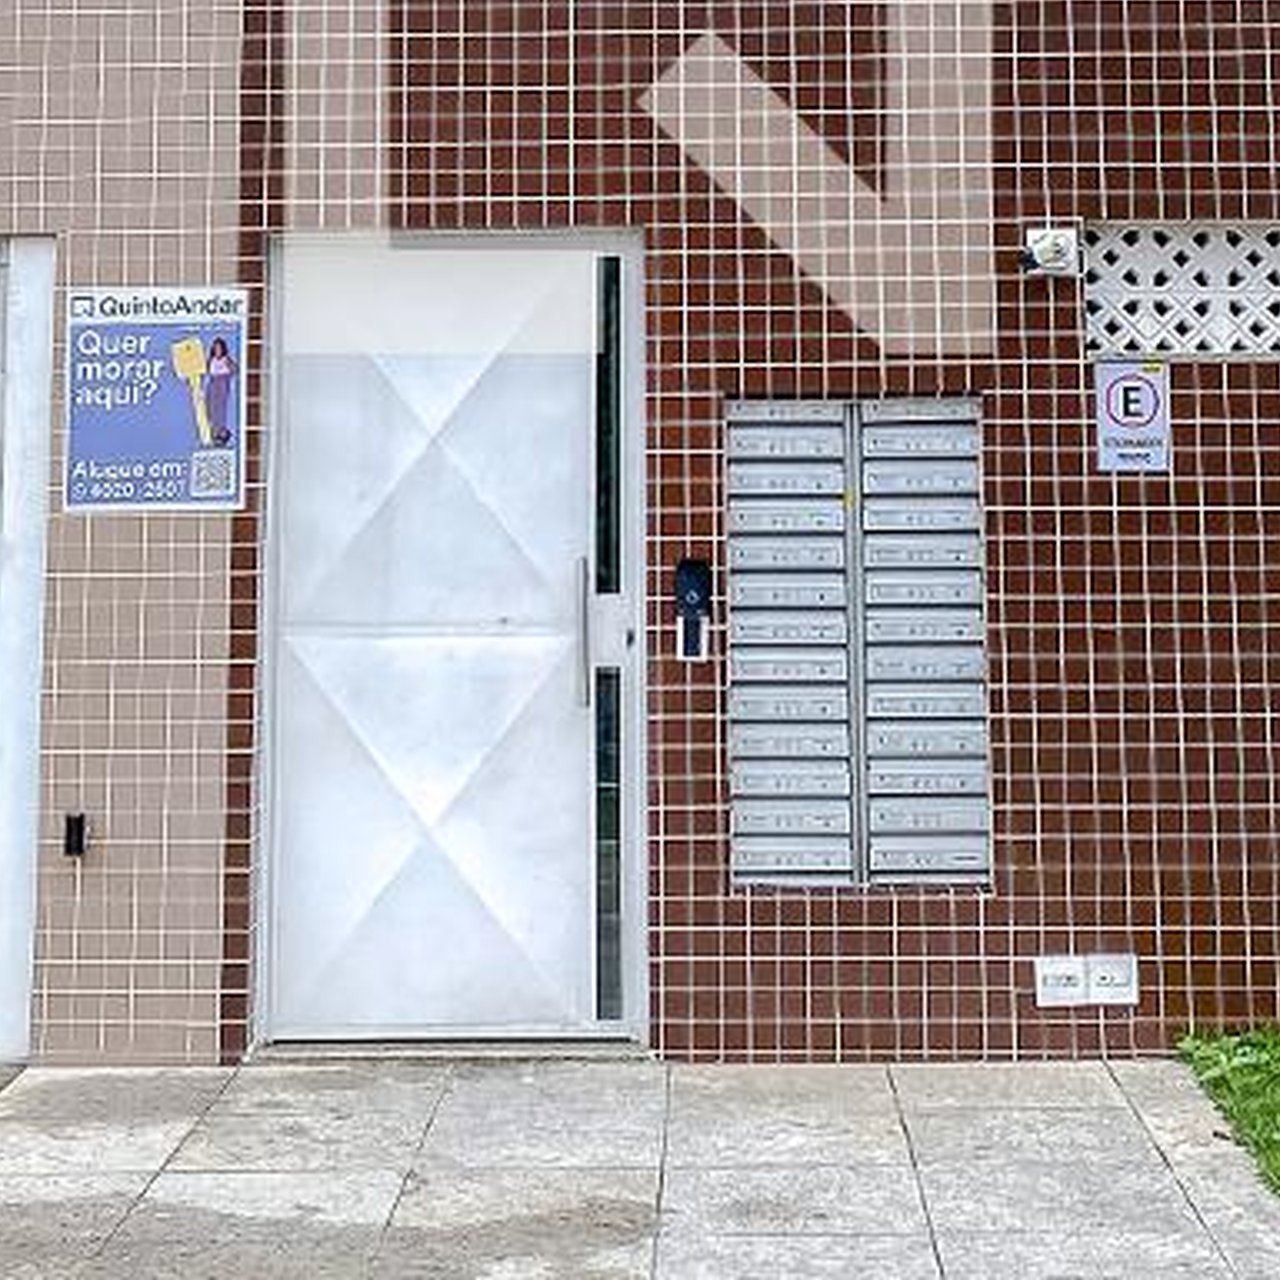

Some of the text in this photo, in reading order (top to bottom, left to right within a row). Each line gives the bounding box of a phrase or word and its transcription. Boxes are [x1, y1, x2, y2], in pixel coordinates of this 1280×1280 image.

[99, 295, 243, 317] QuintoAndar
[78, 330, 151, 357] Quer
[76, 359, 164, 381] morar
[75, 380, 158, 410] aqui?
[1123, 387, 1143, 417] E
